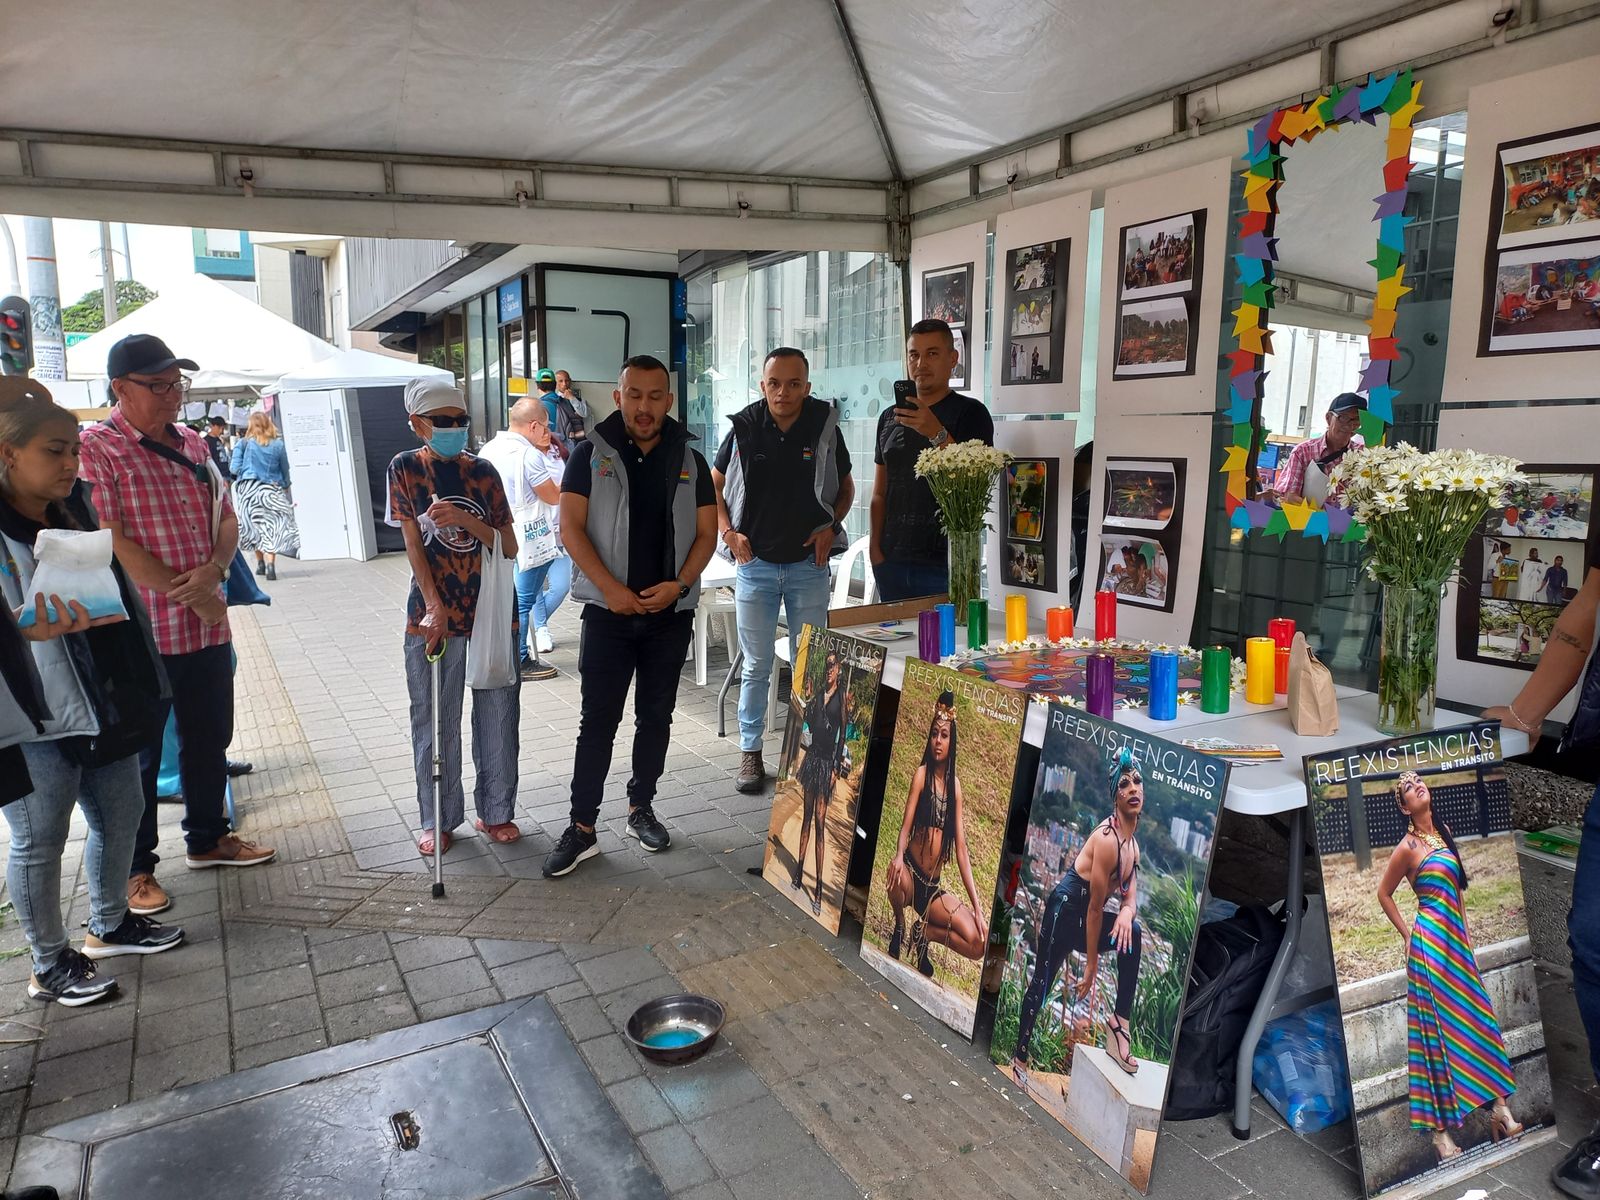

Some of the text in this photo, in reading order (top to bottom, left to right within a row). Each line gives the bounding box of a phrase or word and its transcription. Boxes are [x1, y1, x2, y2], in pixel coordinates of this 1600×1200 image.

[908, 663, 1021, 716] REEXISTENCIAS
[977, 705, 1017, 725] EN TRÁNSITO
[1052, 710, 1217, 788] REEXISTENCIAS
[1315, 727, 1494, 786] REEXISTENCIAS
[1441, 752, 1495, 771] EN TRÁNSITO
[1152, 770, 1213, 800] EN TRÁNSITO
